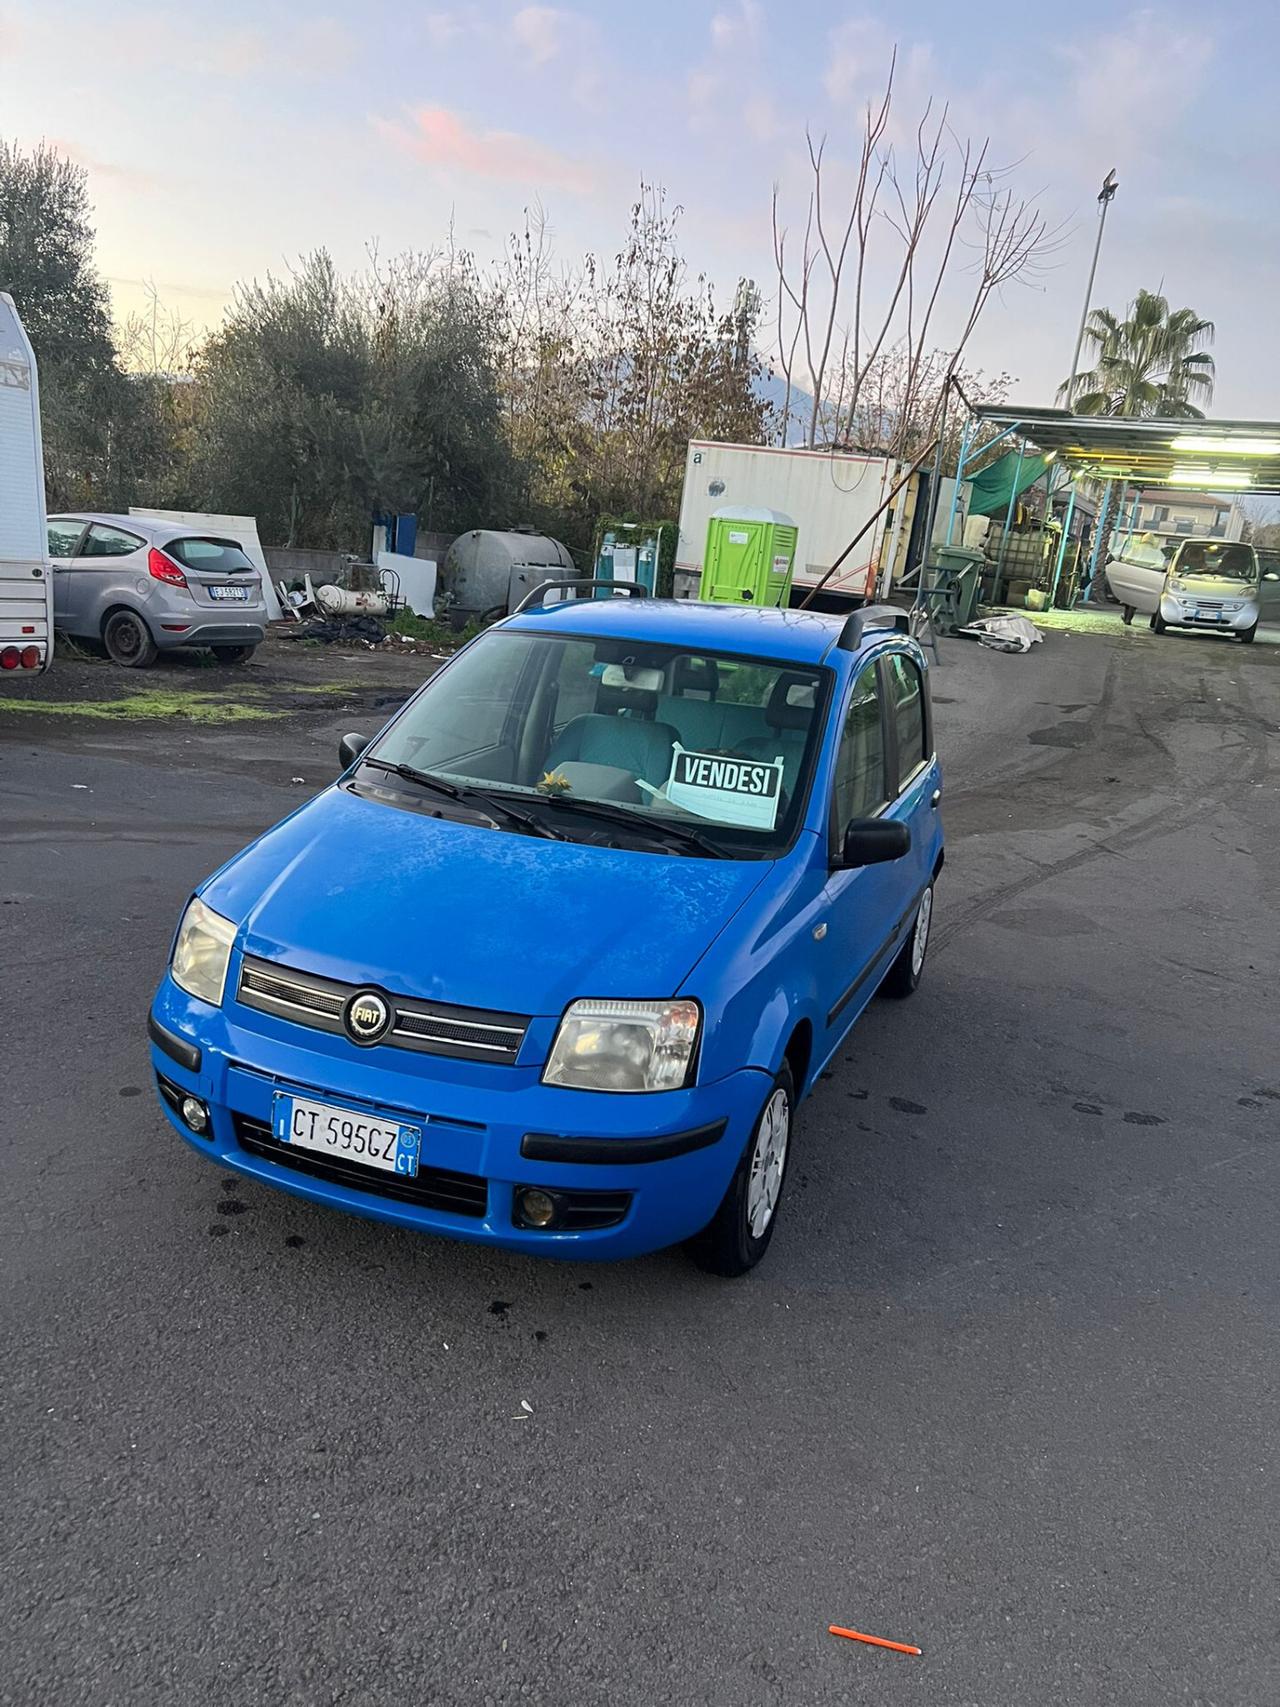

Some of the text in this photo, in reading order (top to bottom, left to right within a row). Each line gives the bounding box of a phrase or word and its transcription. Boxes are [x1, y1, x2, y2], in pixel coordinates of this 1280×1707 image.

[685, 756, 771, 795] VENDESI
[355, 1006, 380, 1024] FIAT
[293, 1108, 397, 1162] CT 595GZ
[397, 1153, 415, 1173] CT
